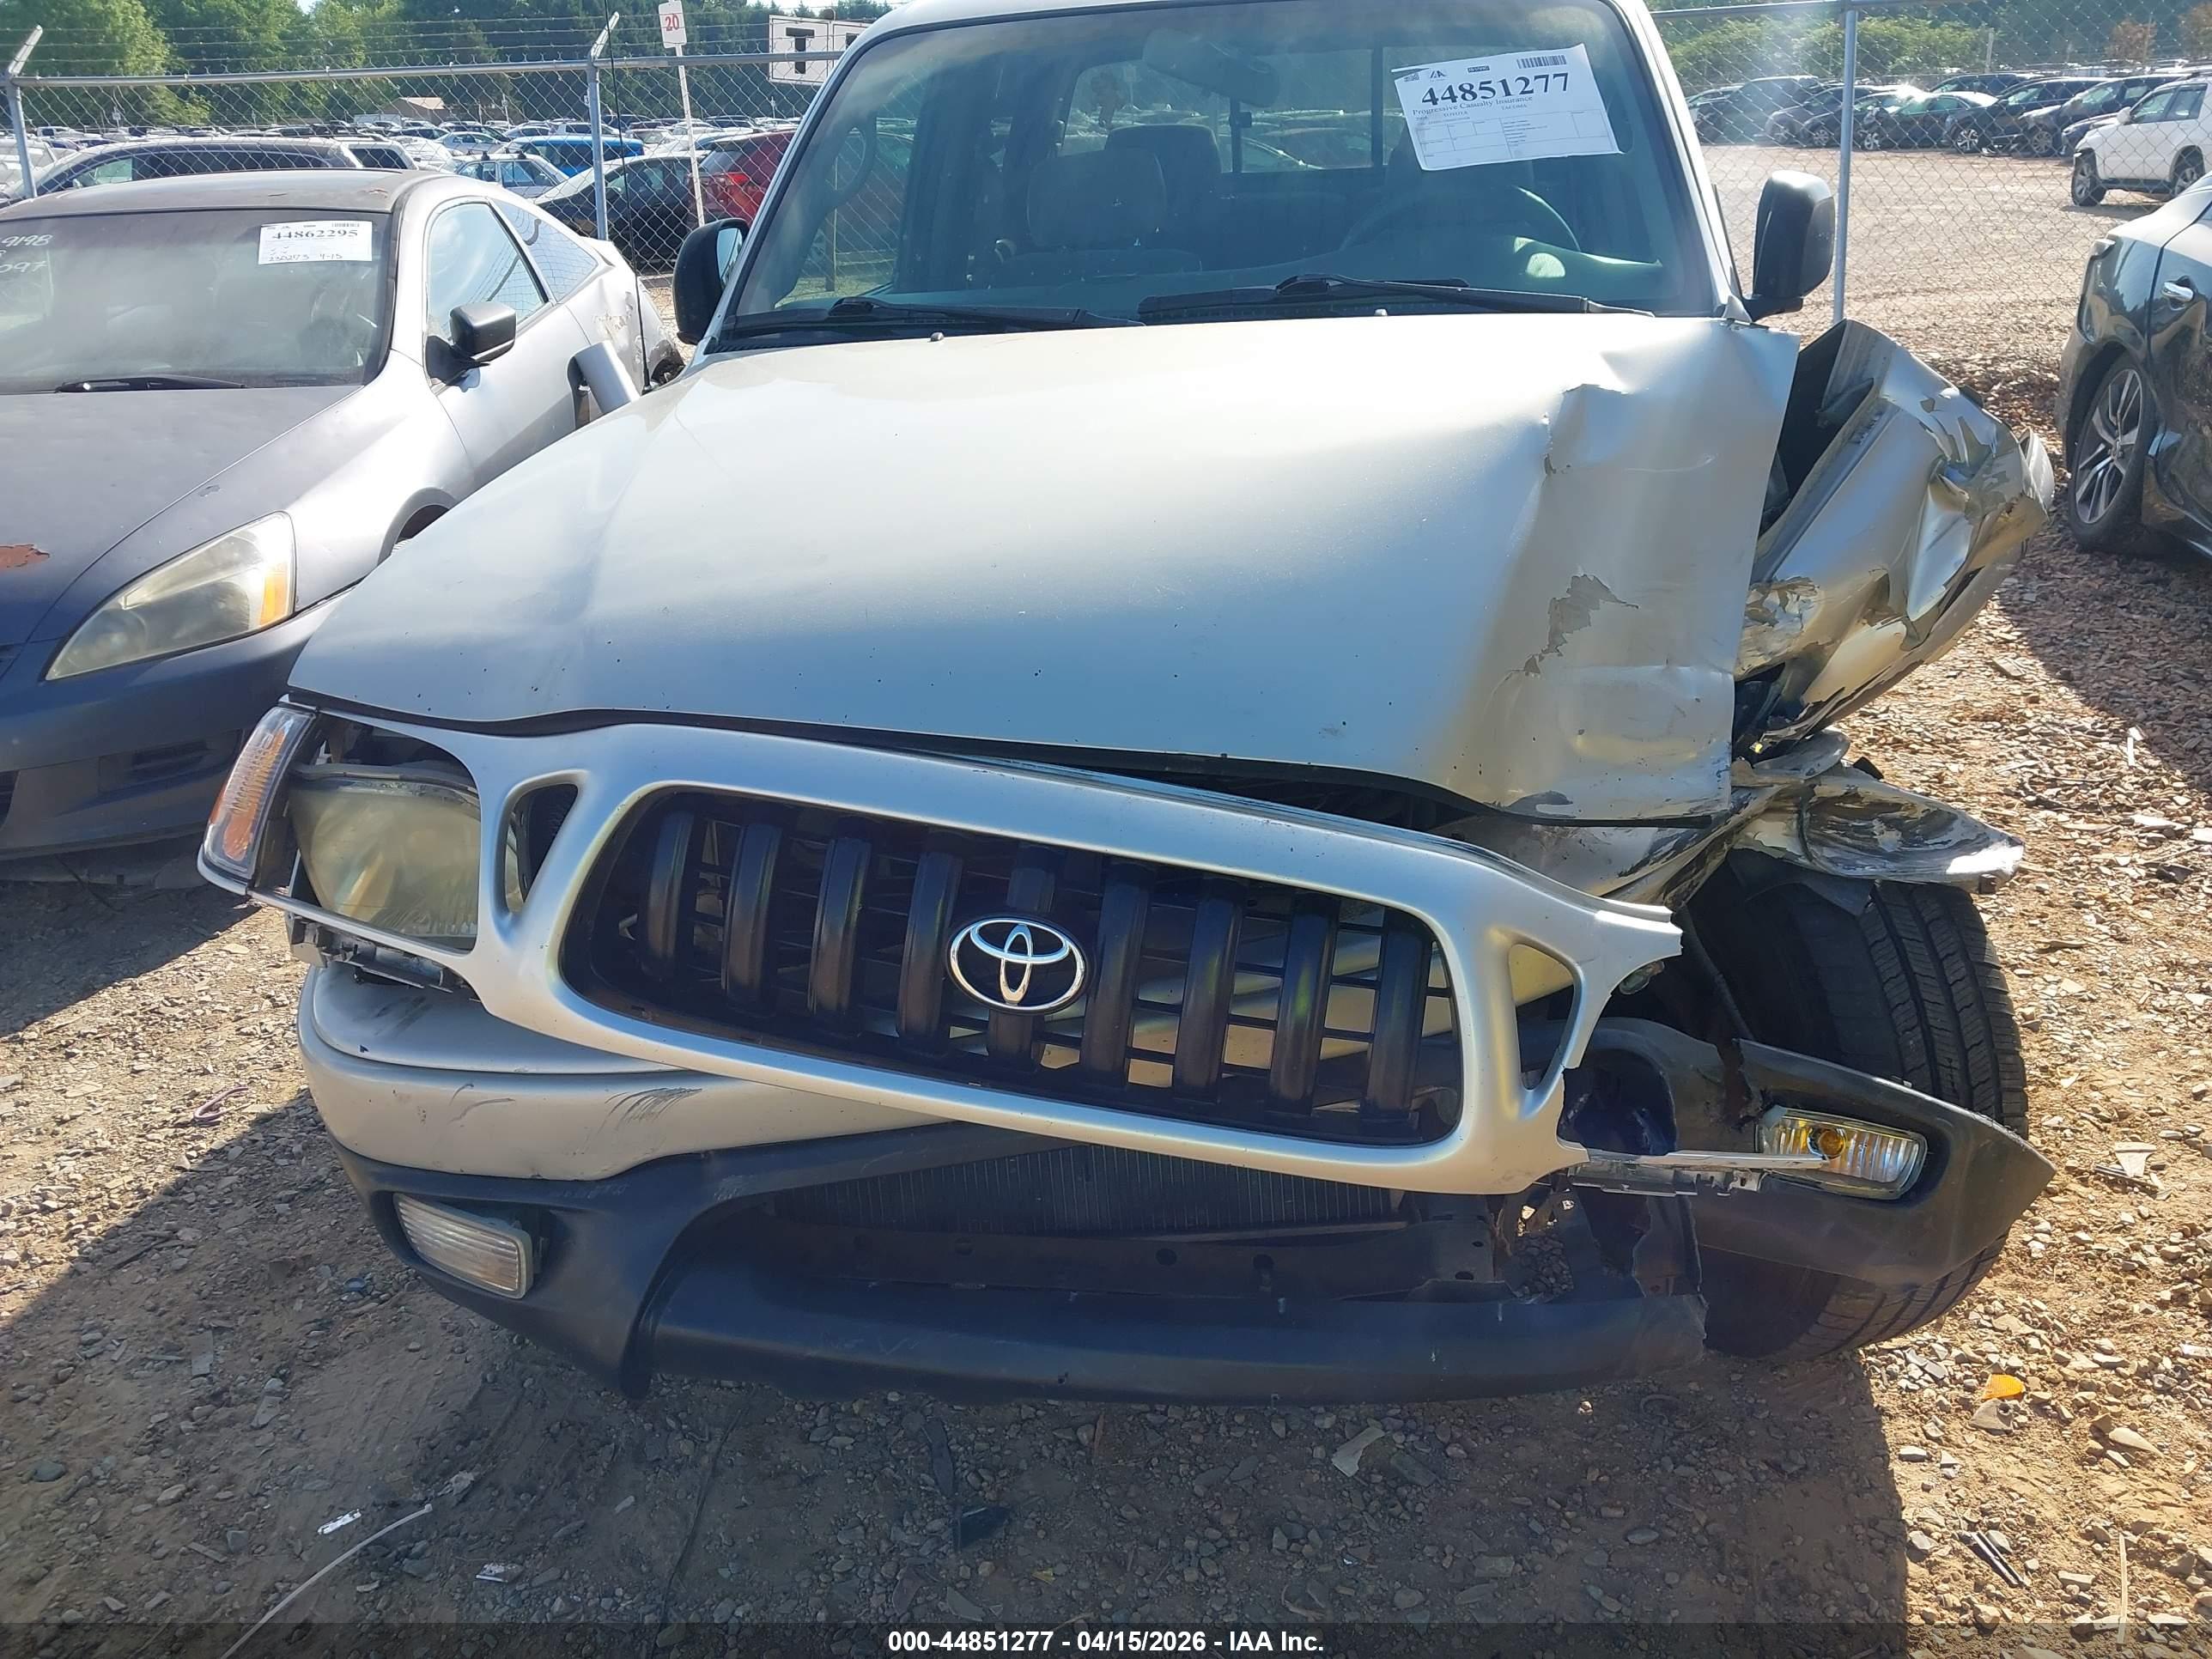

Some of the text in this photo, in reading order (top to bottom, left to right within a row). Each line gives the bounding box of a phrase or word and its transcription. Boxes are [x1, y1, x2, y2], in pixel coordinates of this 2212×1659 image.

[665, 15, 680, 32] 20
[1421, 72, 1569, 106] 44851277
[1412, 96, 1533, 117] Progressive Casualty Insurance
[270, 228, 358, 240] 44862295
